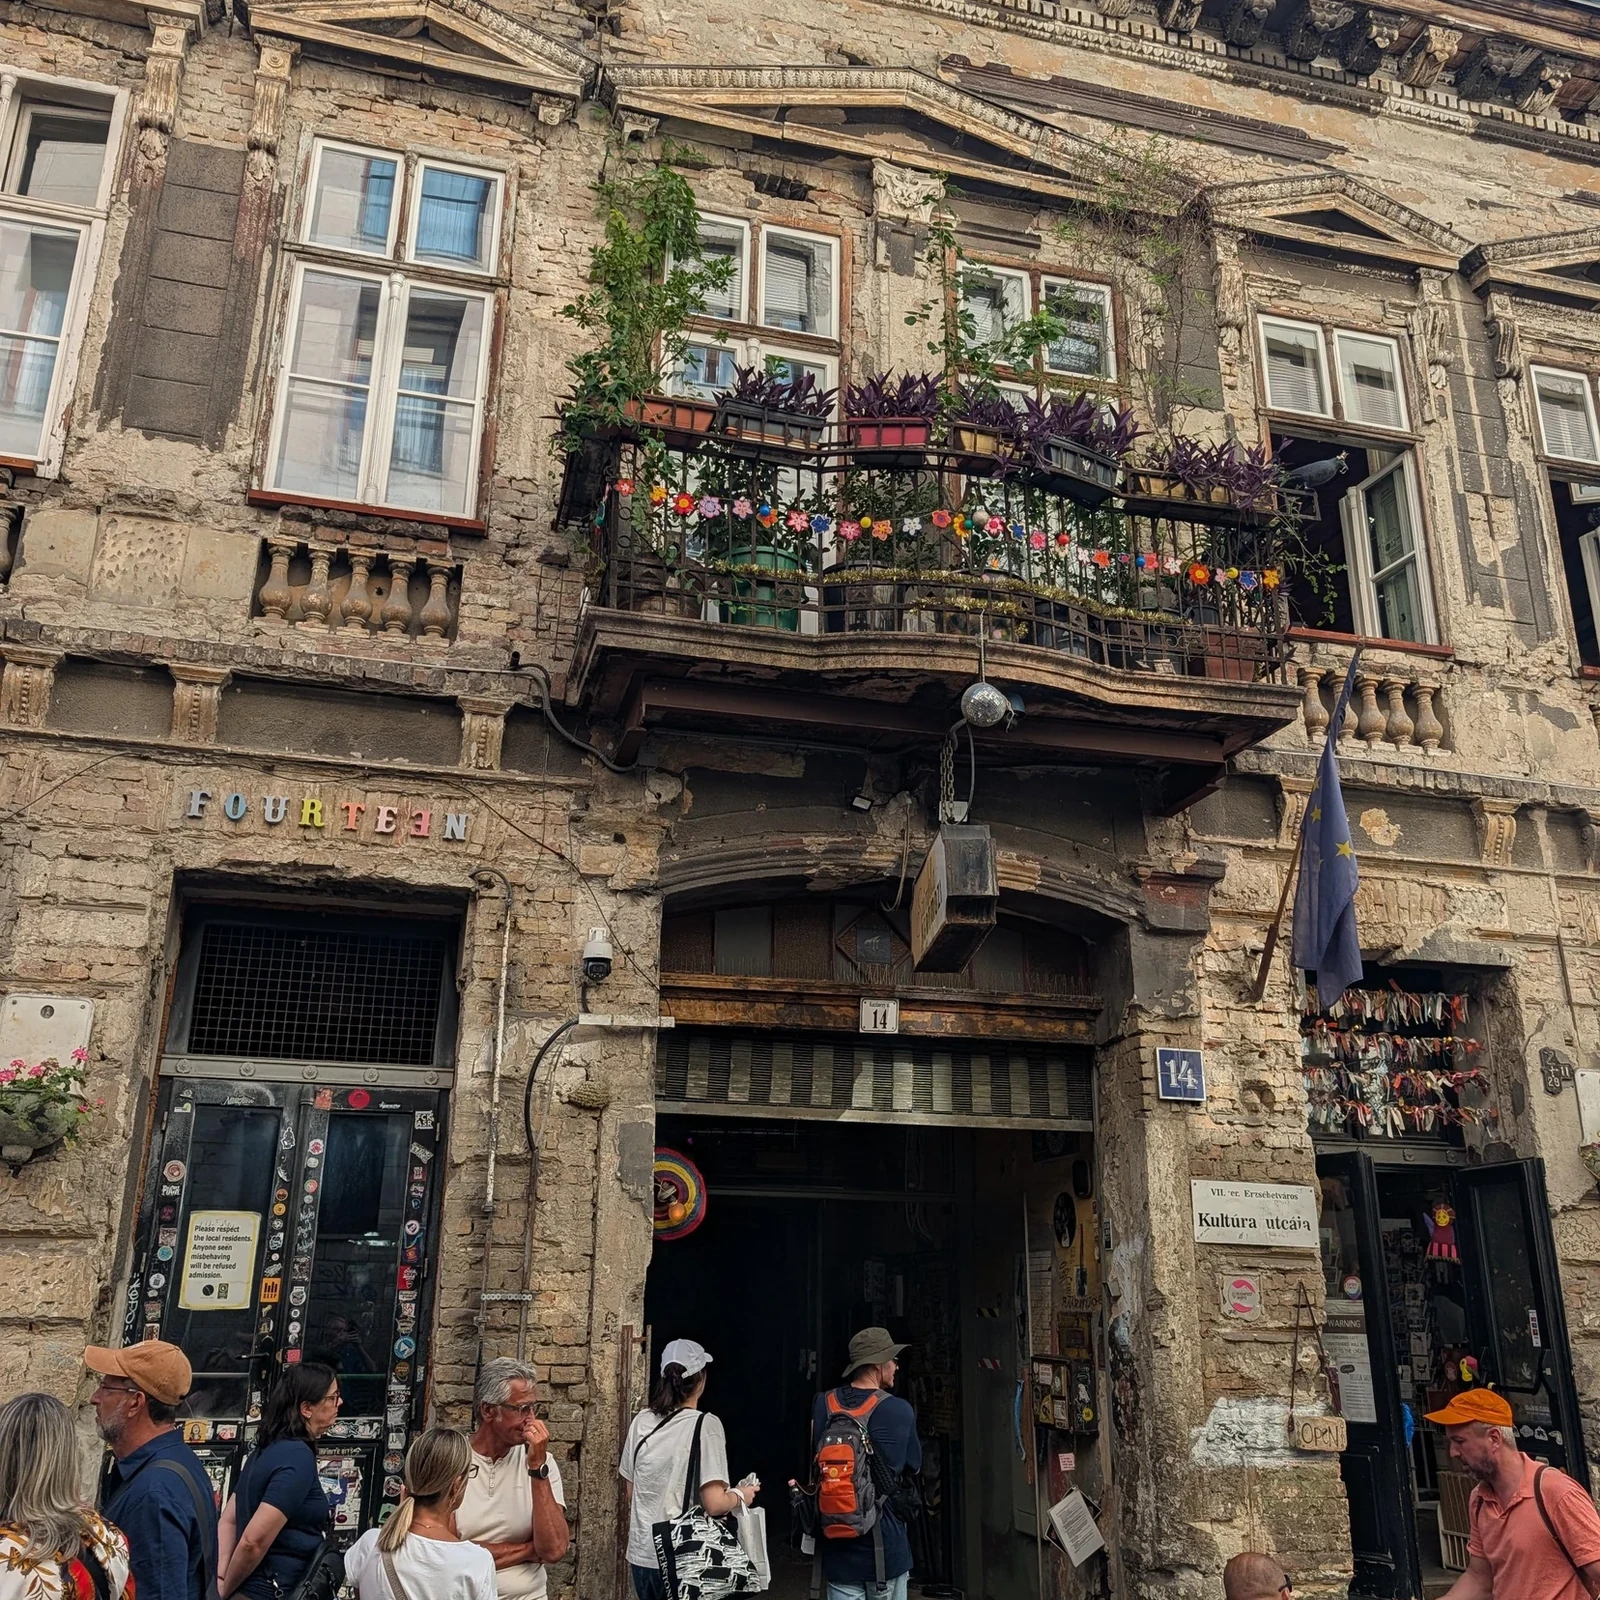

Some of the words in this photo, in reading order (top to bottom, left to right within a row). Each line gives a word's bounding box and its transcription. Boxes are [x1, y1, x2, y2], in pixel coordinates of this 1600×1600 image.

[187, 790, 469, 841] FOURTEEN
[873, 1009, 887, 1029] 14
[1164, 1059, 1199, 1090] 14
[1210, 1188, 1226, 1197] VII.
[1198, 1212, 1258, 1229] Kultúra
[191, 1253, 231, 1261] misbehaving
[188, 1271, 222, 1279] admission.
[1327, 1319, 1361, 1328] WARNING
